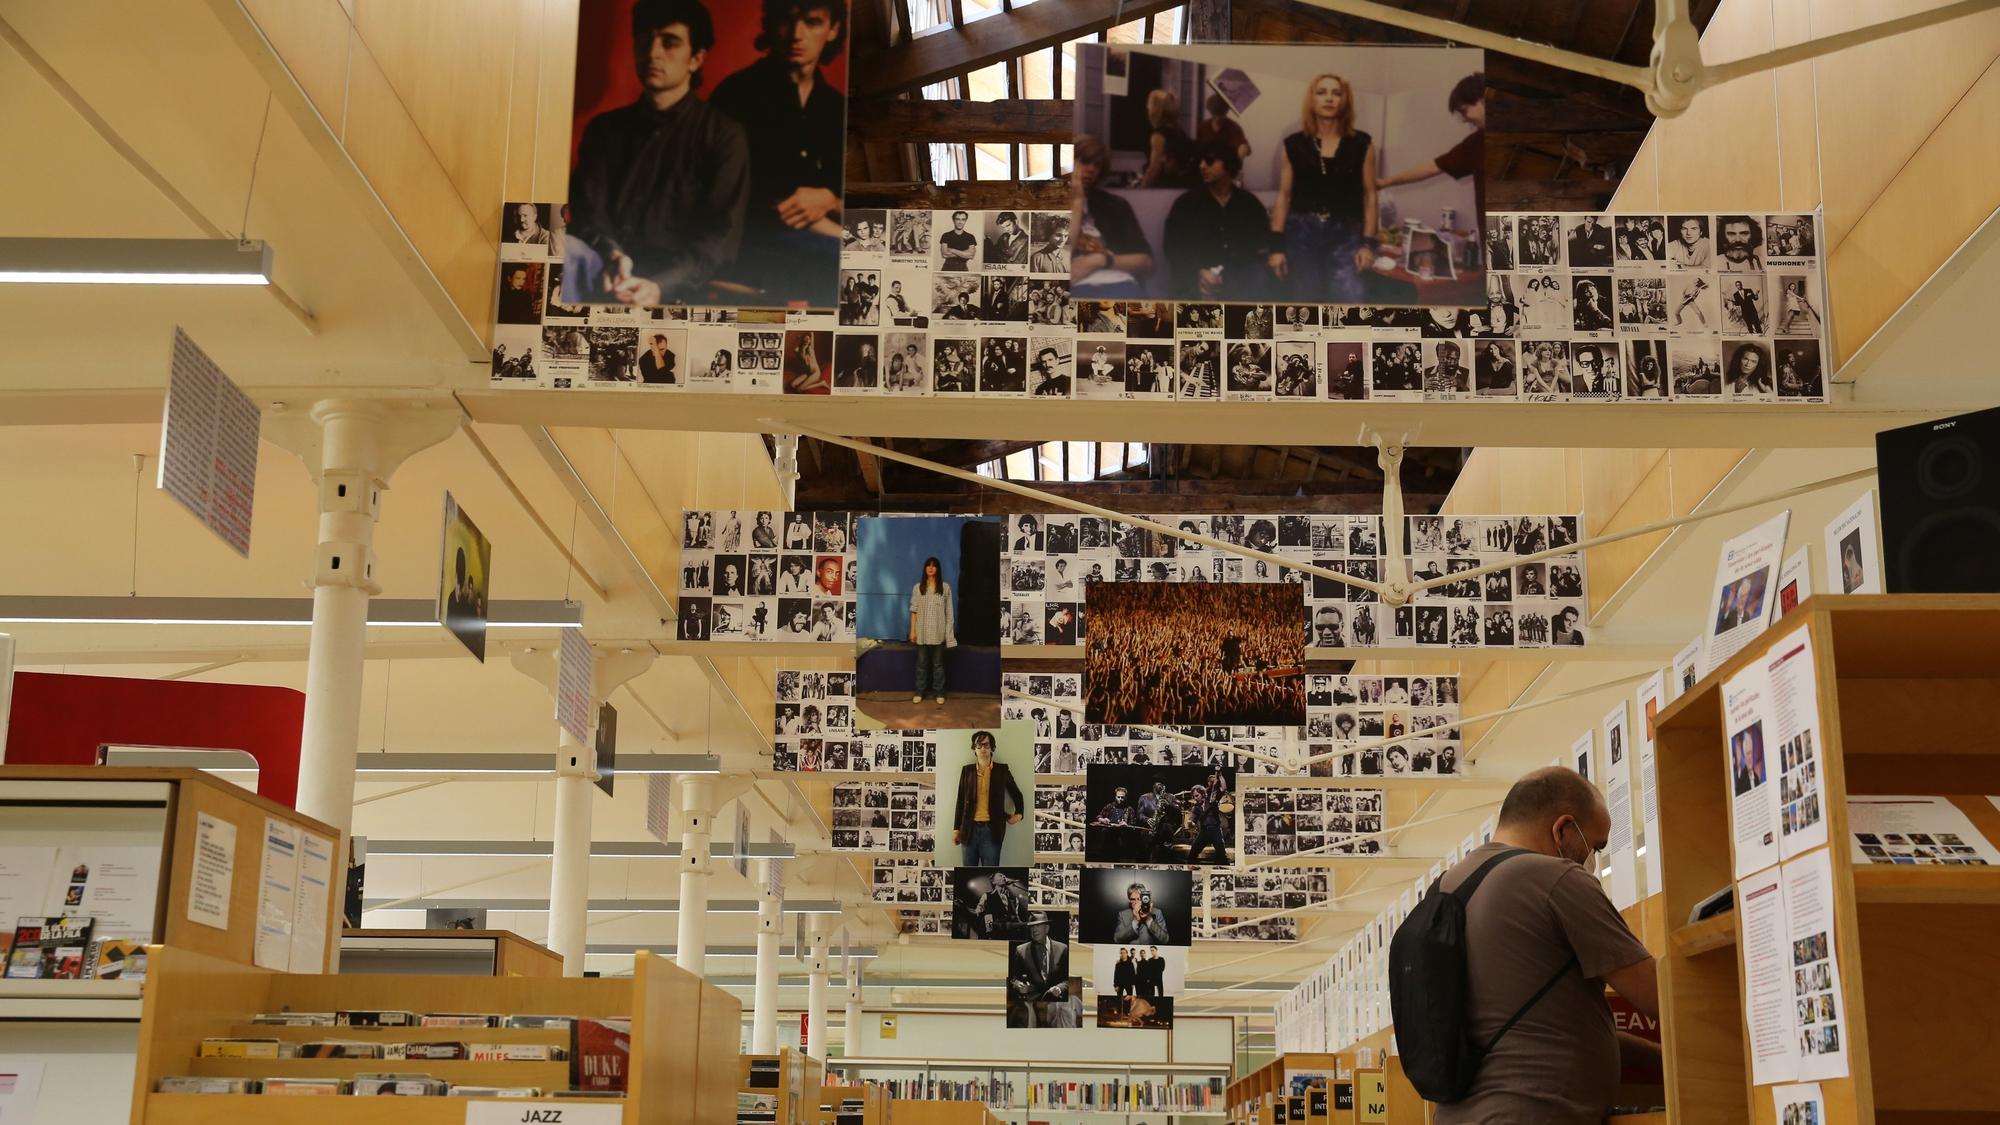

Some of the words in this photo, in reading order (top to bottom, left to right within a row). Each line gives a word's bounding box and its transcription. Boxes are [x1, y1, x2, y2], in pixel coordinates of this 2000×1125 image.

[1528, 394, 1557, 403] HOLE
[1933, 421, 1957, 431] SONY
[52, 931, 62, 939] LA
[1612, 1011, 1657, 1030] EAV
[387, 1045, 405, 1057] JAMES
[407, 1044, 430, 1055] CHANC
[474, 1052, 510, 1061] MILES
[583, 1055, 621, 1077] DUKE
[1339, 1096, 1353, 1104] INT
[1368, 1103, 1385, 1114] NA
[521, 1110, 563, 1123] JAZZ
